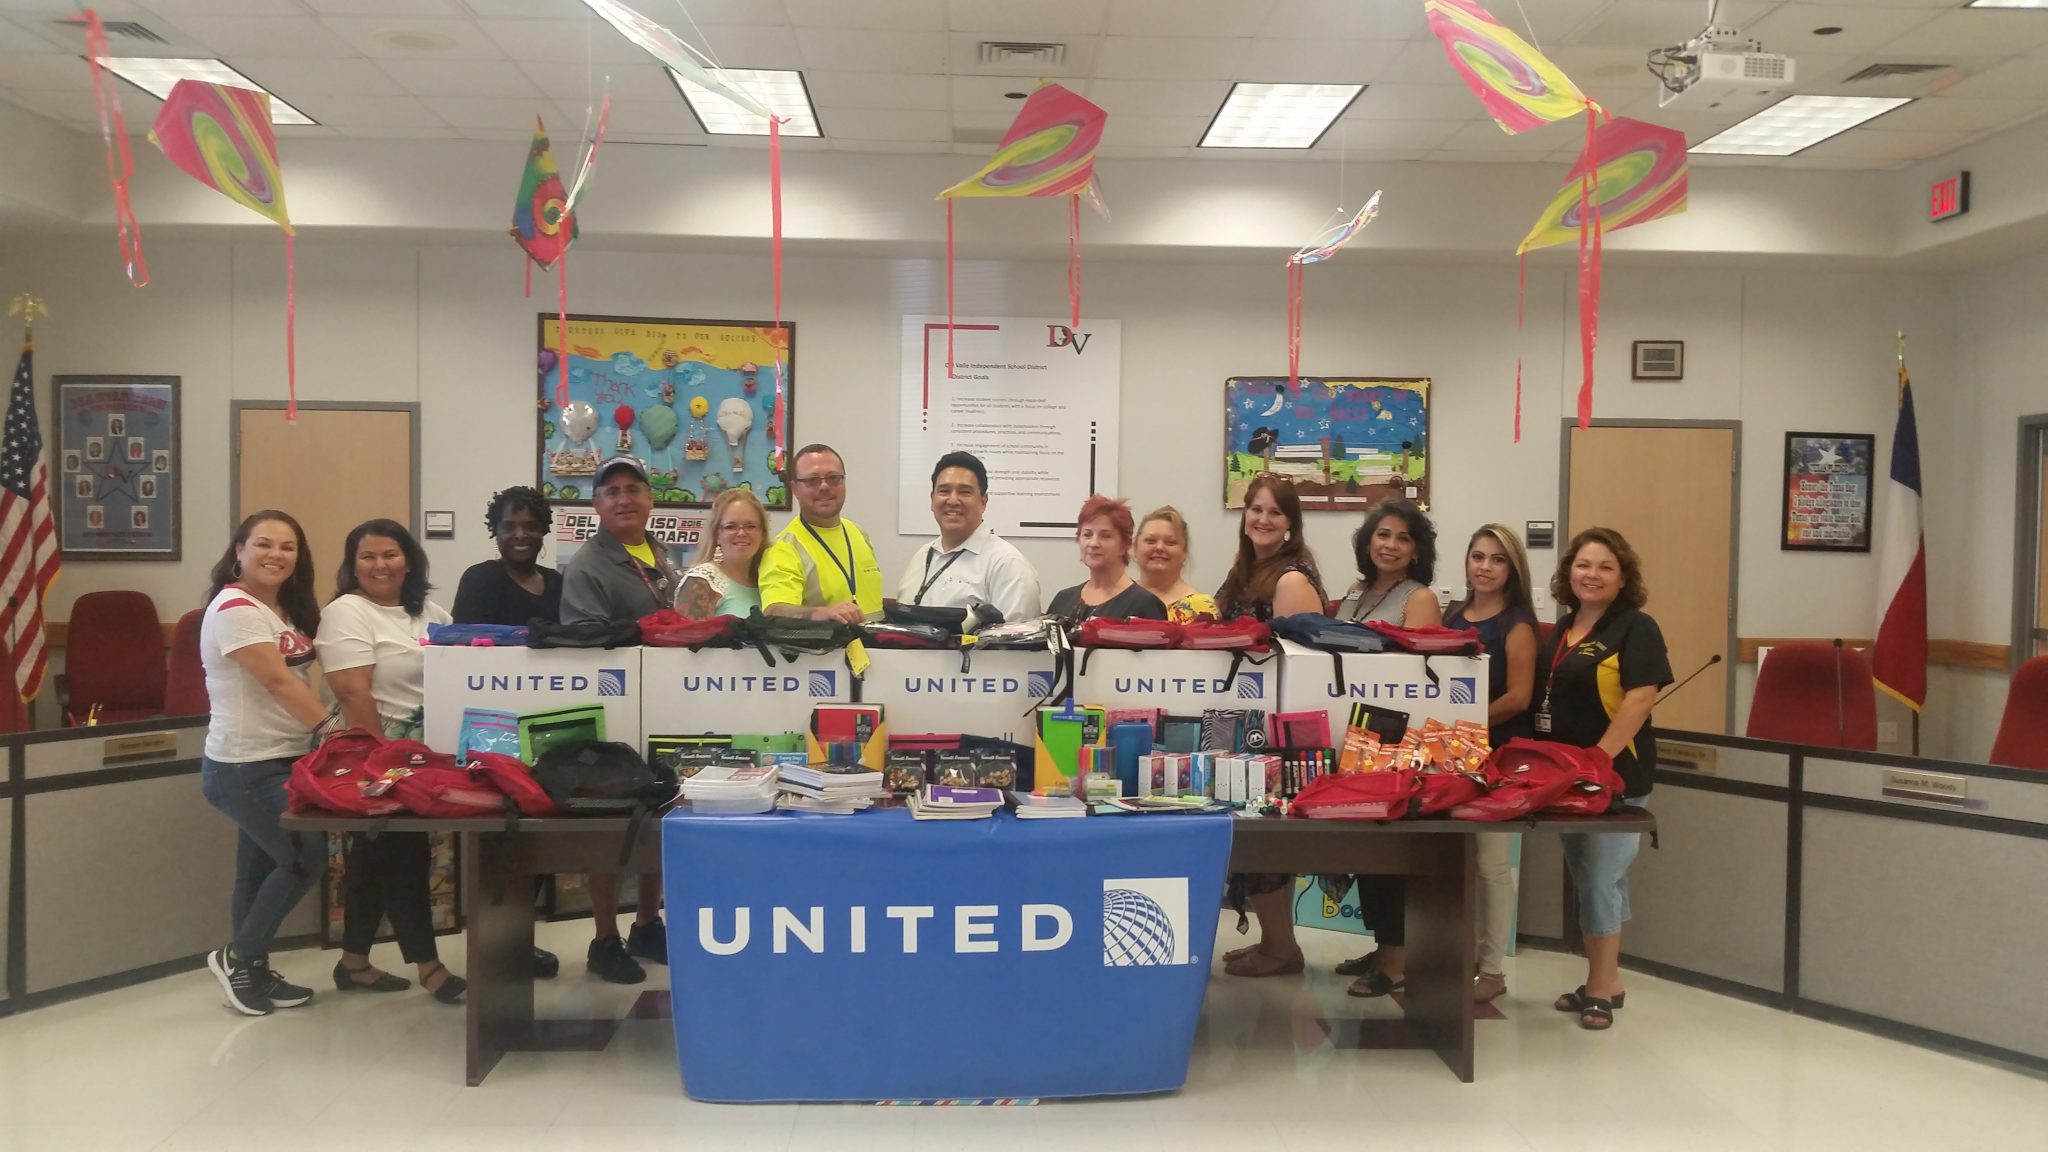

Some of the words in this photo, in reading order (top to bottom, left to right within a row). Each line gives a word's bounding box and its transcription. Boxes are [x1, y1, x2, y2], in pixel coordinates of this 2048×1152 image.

[1931, 177, 1958, 218] EXIT
[566, 516, 596, 527] DEL
[650, 518, 677, 529] ISD
[650, 531, 699, 543] OARD
[467, 675, 589, 691] UNITED
[683, 676, 801, 692] UNITED
[905, 677, 1019, 693] UNITED
[1115, 678, 1229, 693] UNITED
[1327, 683, 1441, 698] UNITED
[698, 904, 1074, 955] UNITED
